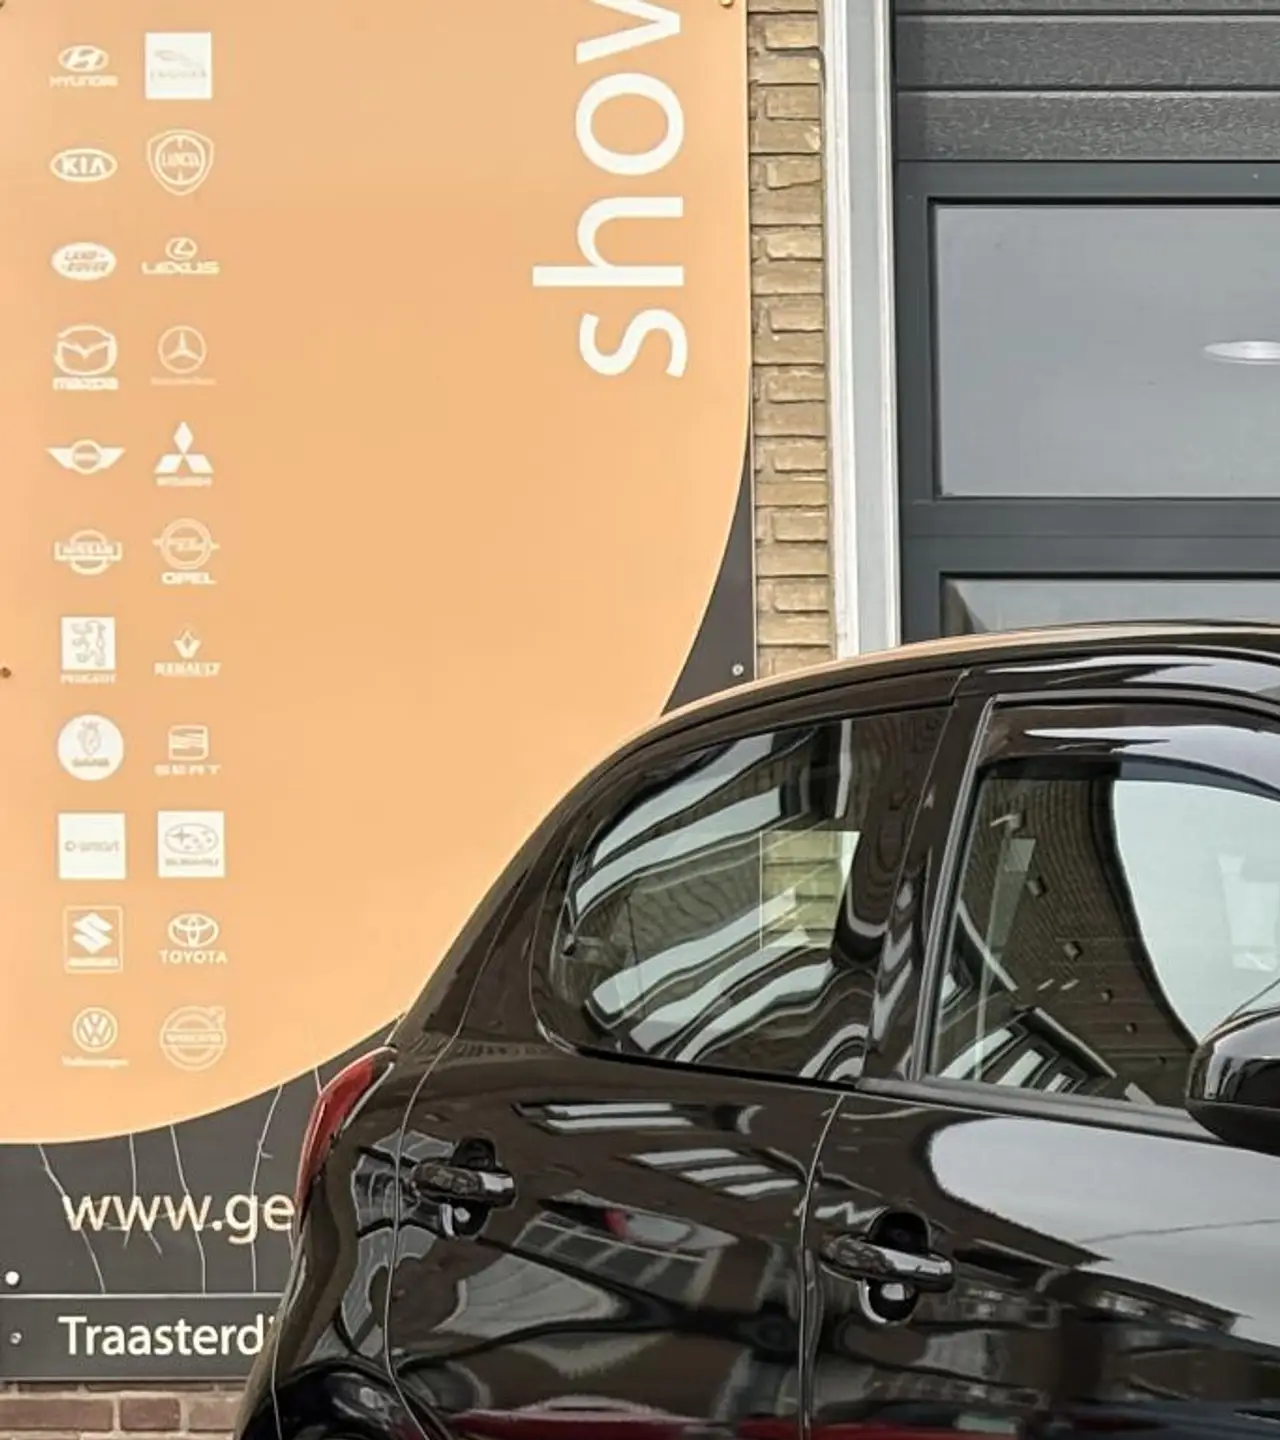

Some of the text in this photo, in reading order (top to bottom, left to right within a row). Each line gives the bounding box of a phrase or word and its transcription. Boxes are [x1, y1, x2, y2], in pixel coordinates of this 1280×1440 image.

[60, 155, 107, 175] KIA
[141, 261, 220, 275] LEXUS
[161, 572, 216, 584] OPEL
[159, 950, 228, 964] TOYOTA
[58, 1314, 275, 1355] Traasterd
